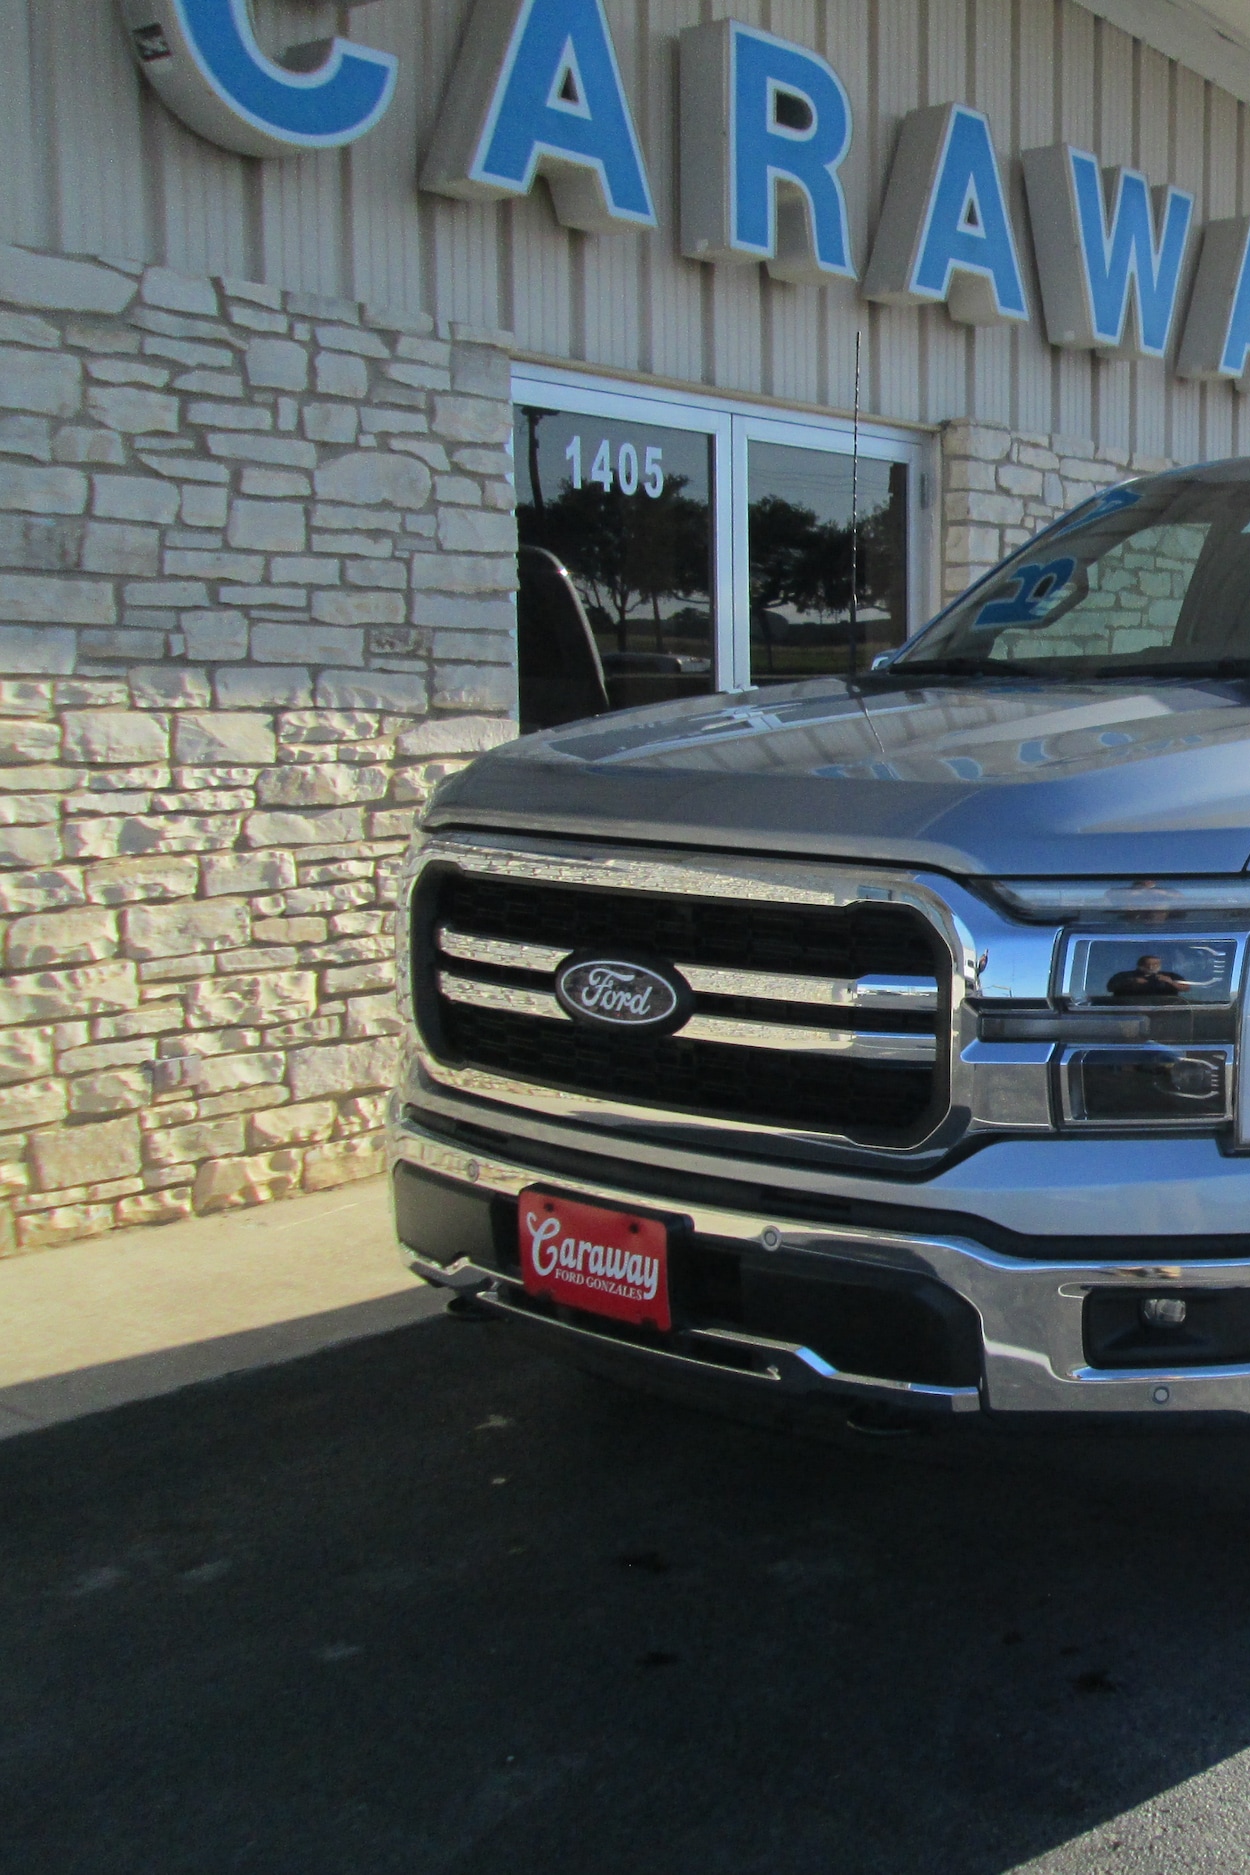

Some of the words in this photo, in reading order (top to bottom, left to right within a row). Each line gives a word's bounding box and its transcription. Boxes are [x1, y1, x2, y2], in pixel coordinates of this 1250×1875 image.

[565, 435, 664, 499] 1405
[581, 967, 653, 1015] Ford
[526, 1211, 659, 1301] Caraway
[554, 1268, 585, 1285] FORD
[585, 1276, 643, 1301] GONZALES
